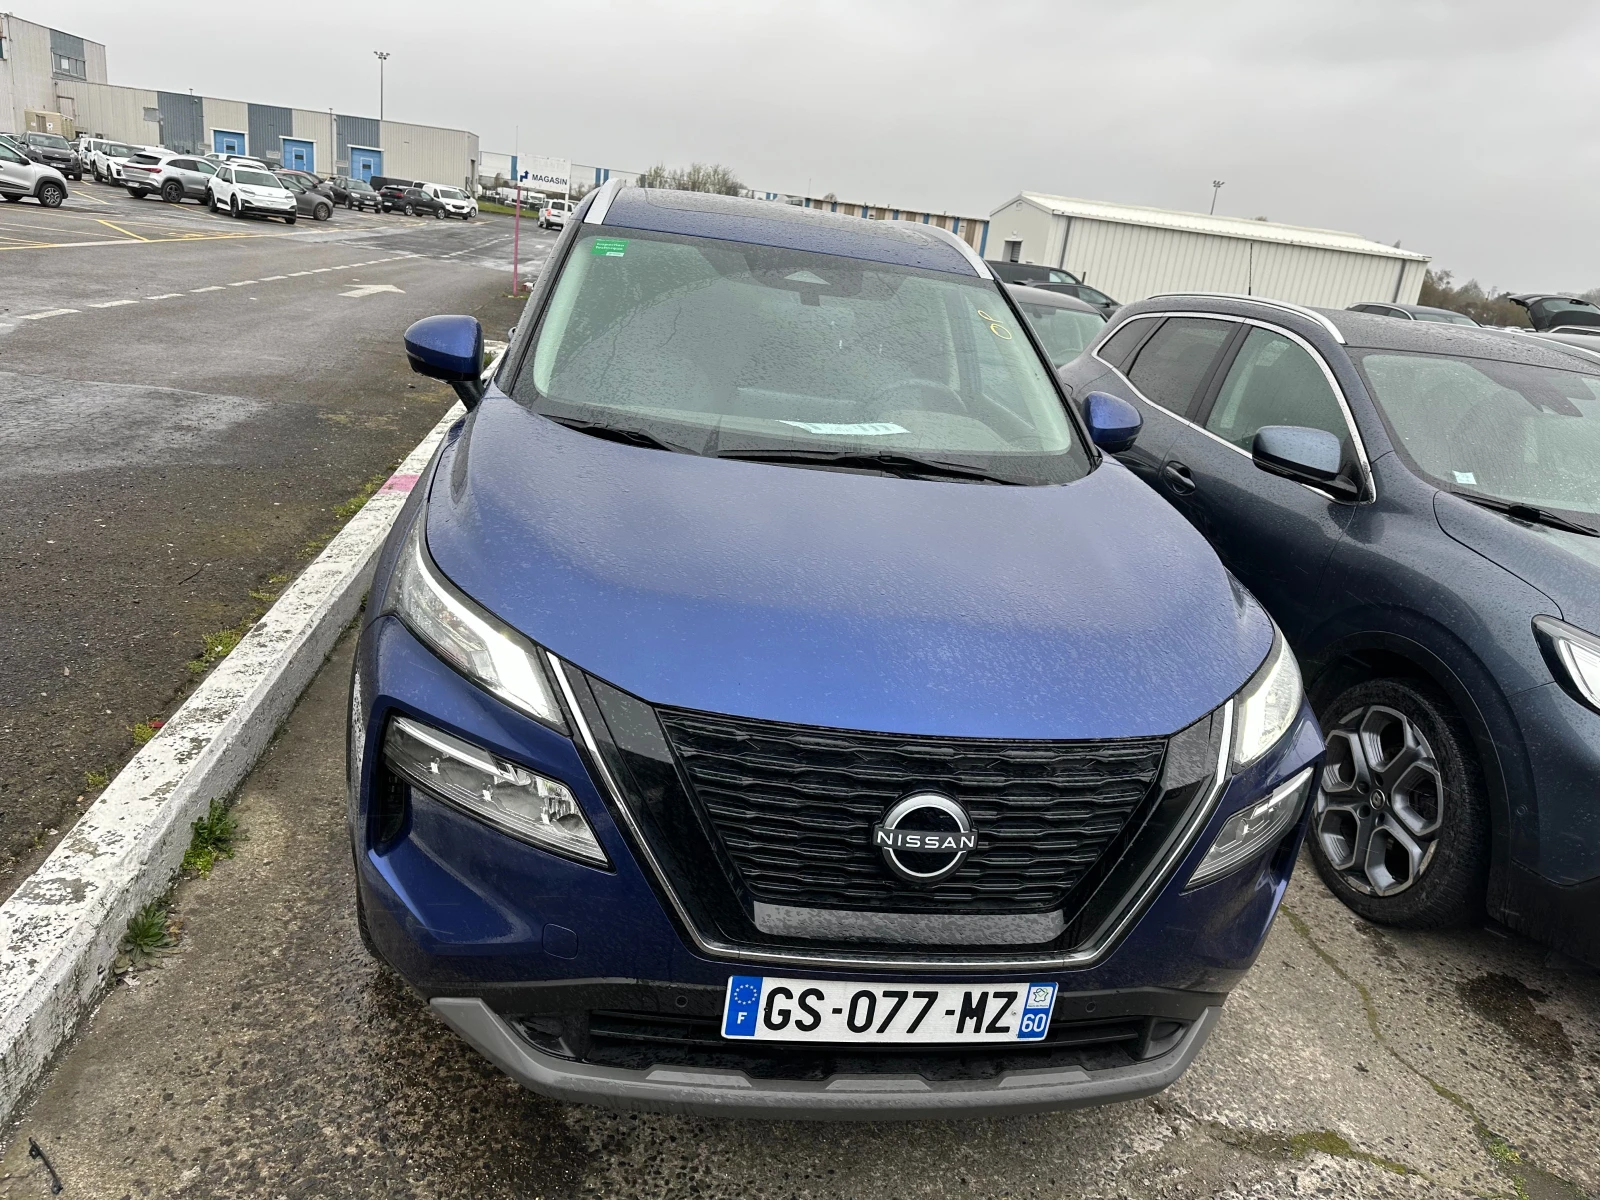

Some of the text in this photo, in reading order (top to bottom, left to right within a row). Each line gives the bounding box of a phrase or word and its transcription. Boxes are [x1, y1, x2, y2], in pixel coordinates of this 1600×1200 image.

[532, 174, 567, 186] MAGASIN
[876, 831, 975, 849] NISSAN
[736, 986, 1047, 1035] F GS-077-MZ 60
